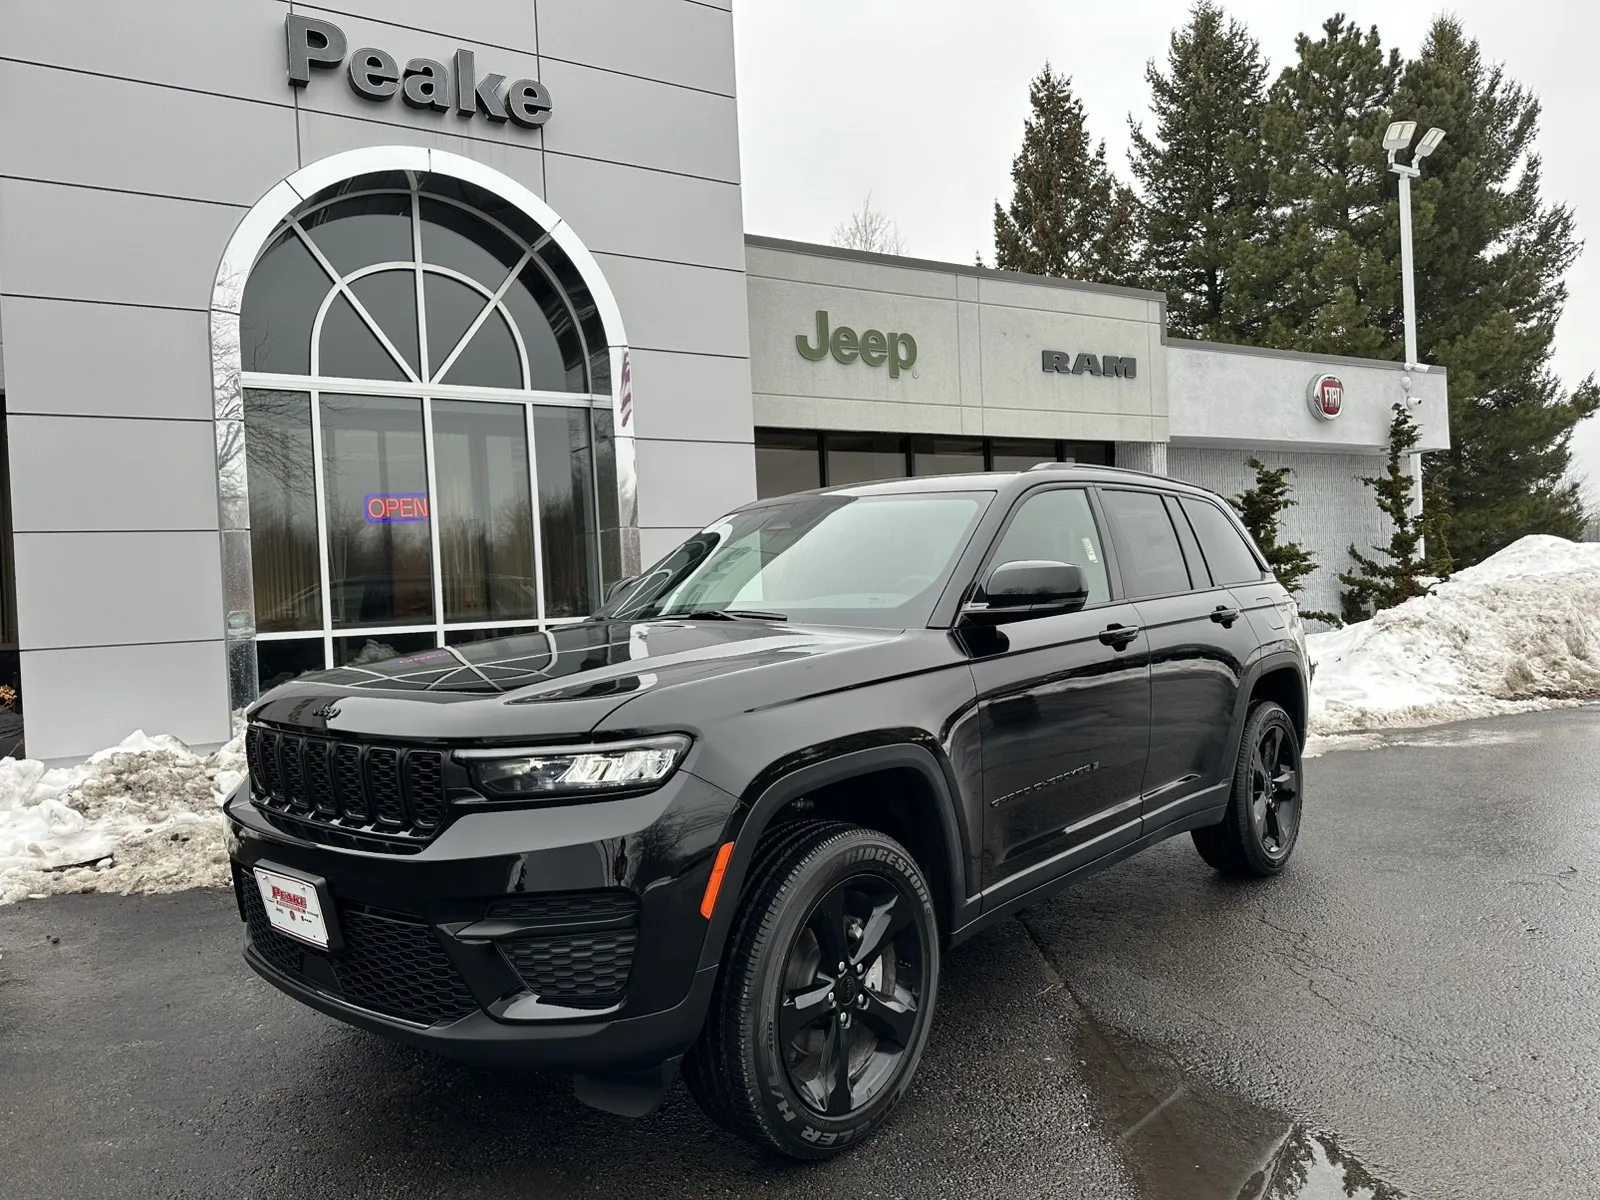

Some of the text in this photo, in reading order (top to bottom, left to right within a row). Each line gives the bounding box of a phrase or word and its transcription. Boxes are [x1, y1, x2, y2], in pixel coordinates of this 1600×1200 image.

[285, 13, 552, 129] Peake
[795, 310, 918, 379] Jeep
[1042, 350, 1136, 378] RAM
[1323, 386, 1341, 408] FIAT
[368, 498, 428, 518] OPEN
[840, 847, 932, 915] RIDGESTONE
[271, 885, 307, 909] PEAKE
